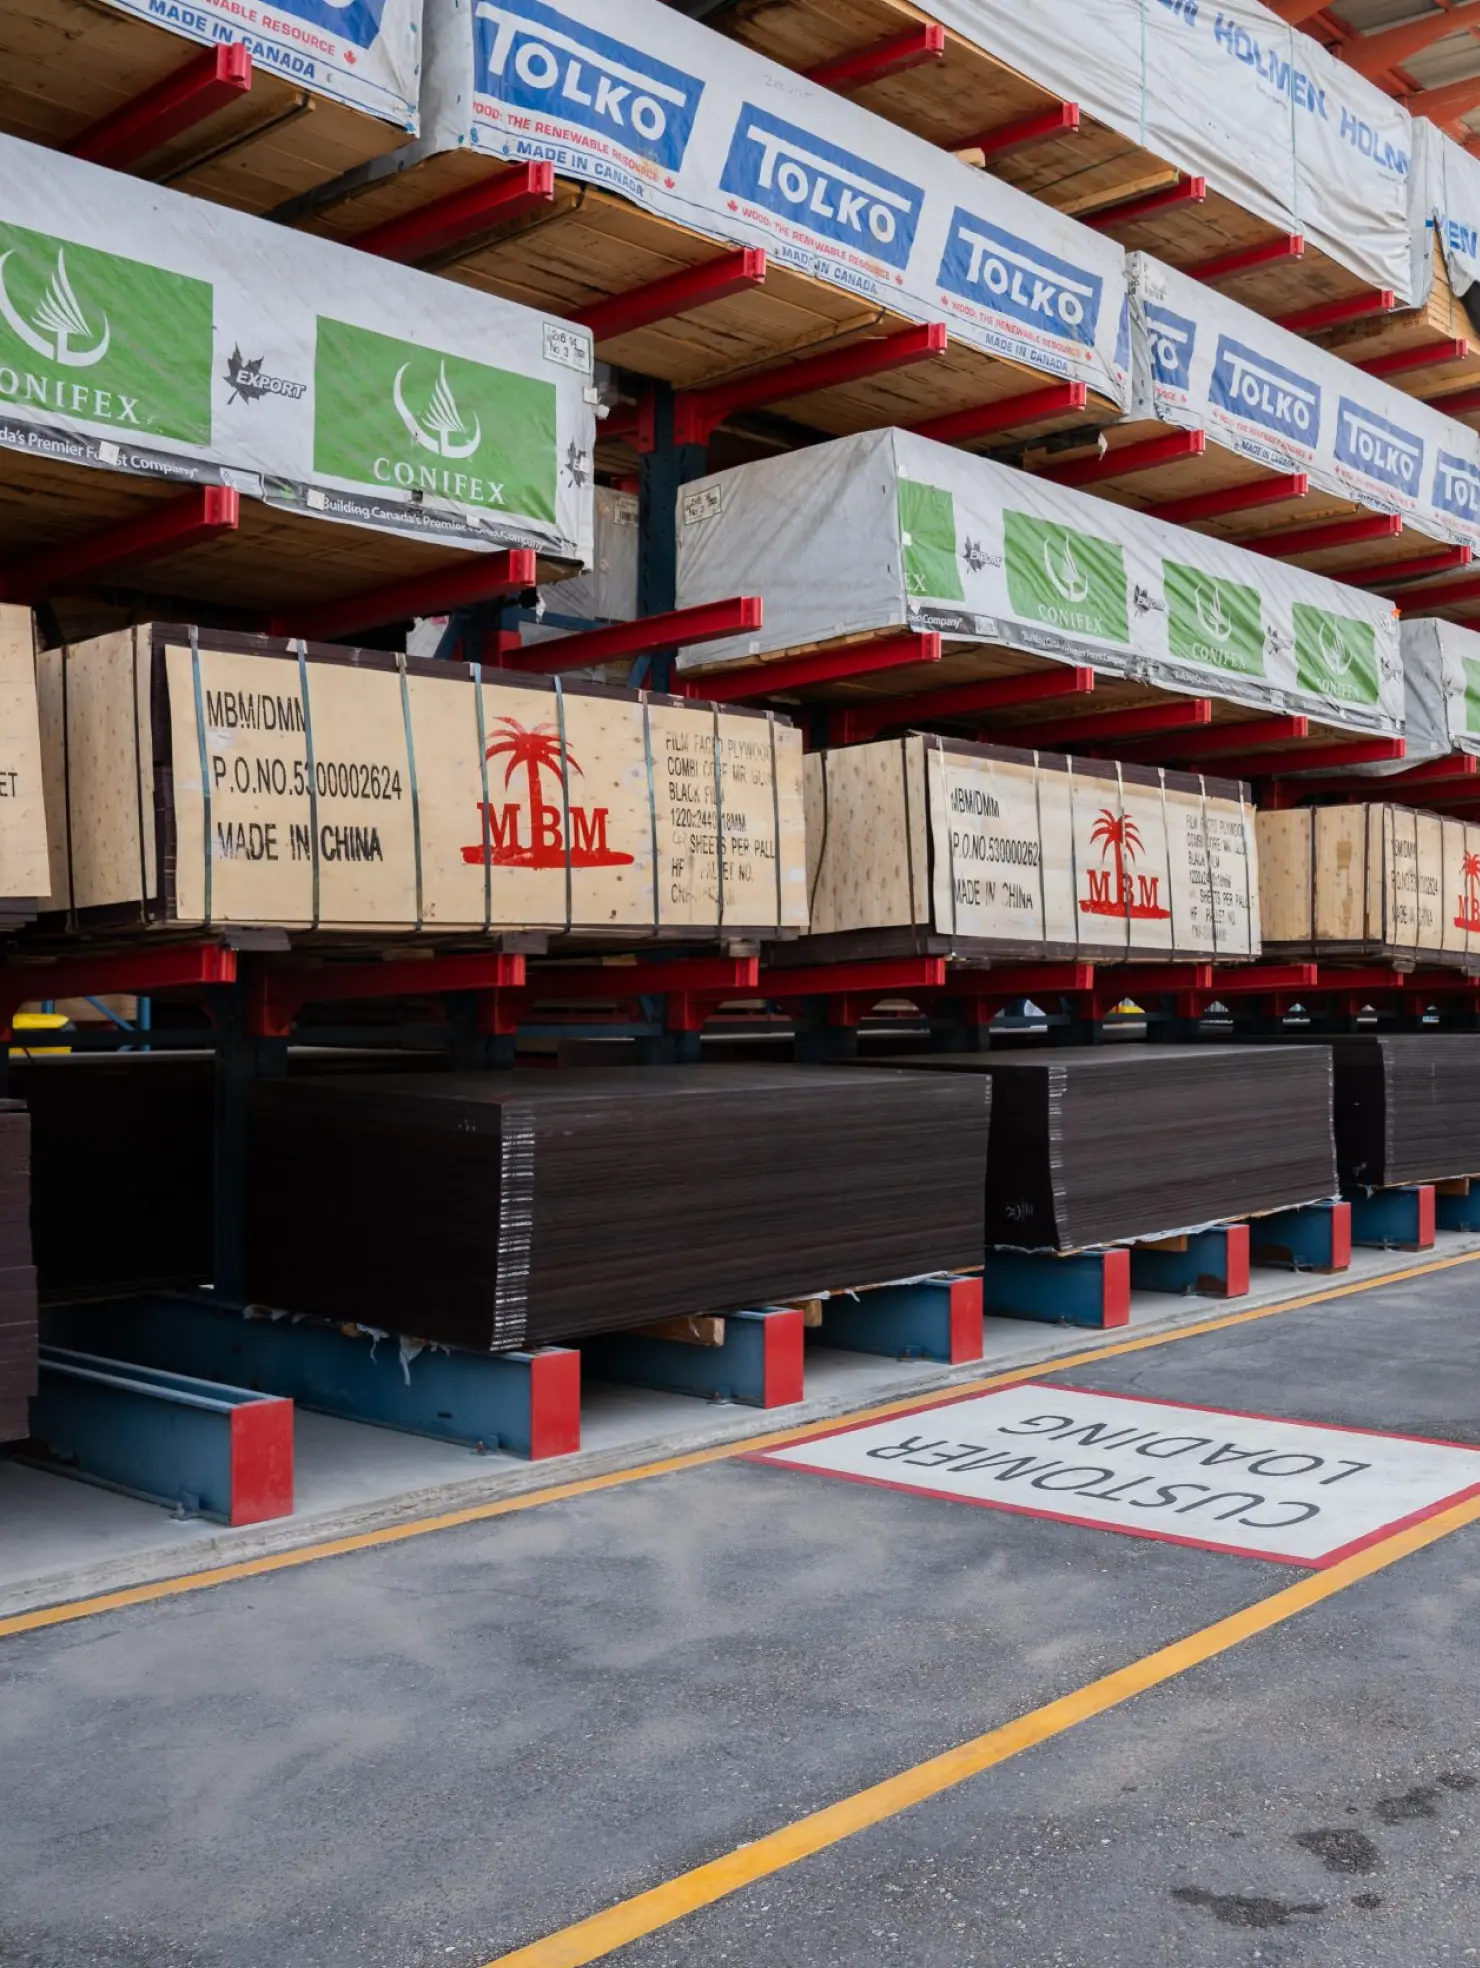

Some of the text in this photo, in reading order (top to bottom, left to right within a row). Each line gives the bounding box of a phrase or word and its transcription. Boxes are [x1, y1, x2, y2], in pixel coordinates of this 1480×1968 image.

[148, 0, 316, 80] MADE IN CANADA
[262, 15, 335, 56] RESOURCE
[475, 2, 688, 142] TOLKO
[1213, 12, 1329, 121] HOLMEN
[507, 114, 531, 130] THE
[535, 120, 609, 154] RENEWABLE
[516, 140, 645, 198] MADE IN CANADA
[747, 124, 912, 244] TOLKO
[775, 221, 790, 238] THE
[833, 266, 878, 294] CANADA
[957, 226, 1093, 326] TOLKO
[979, 311, 994, 326] THE
[984, 333, 1068, 372] MADE IN CANADA
[235, 369, 308, 400] EXPORT
[1223, 350, 1316, 431] TOLKO
[27, 431, 84, 458] Premier
[1343, 410, 1420, 483] TOLKO
[373, 457, 506, 506] CONIFEX
[323, 497, 370, 520] Building
[371, 506, 422, 526] Canada's
[1038, 604, 1102, 634] CONIFEX
[666, 731, 772, 762] FILM FACD PLYWOO
[667, 756, 698, 777] COMBI
[668, 781, 701, 803] BLACK
[950, 787, 1000, 819] MBM/DMM
[217, 822, 384, 862] MADE IN CHINA
[476, 801, 611, 853] MBM
[690, 834, 727, 856] SHEES
[731, 836, 750, 857] PER
[952, 832, 1040, 868] P.O.NO.530000262
[953, 878, 981, 906] MADE
[1086, 868, 1159, 910] MBM
[997, 1415, 1372, 1485] LOADING
[866, 1435, 1321, 1528] CUSTOMER
